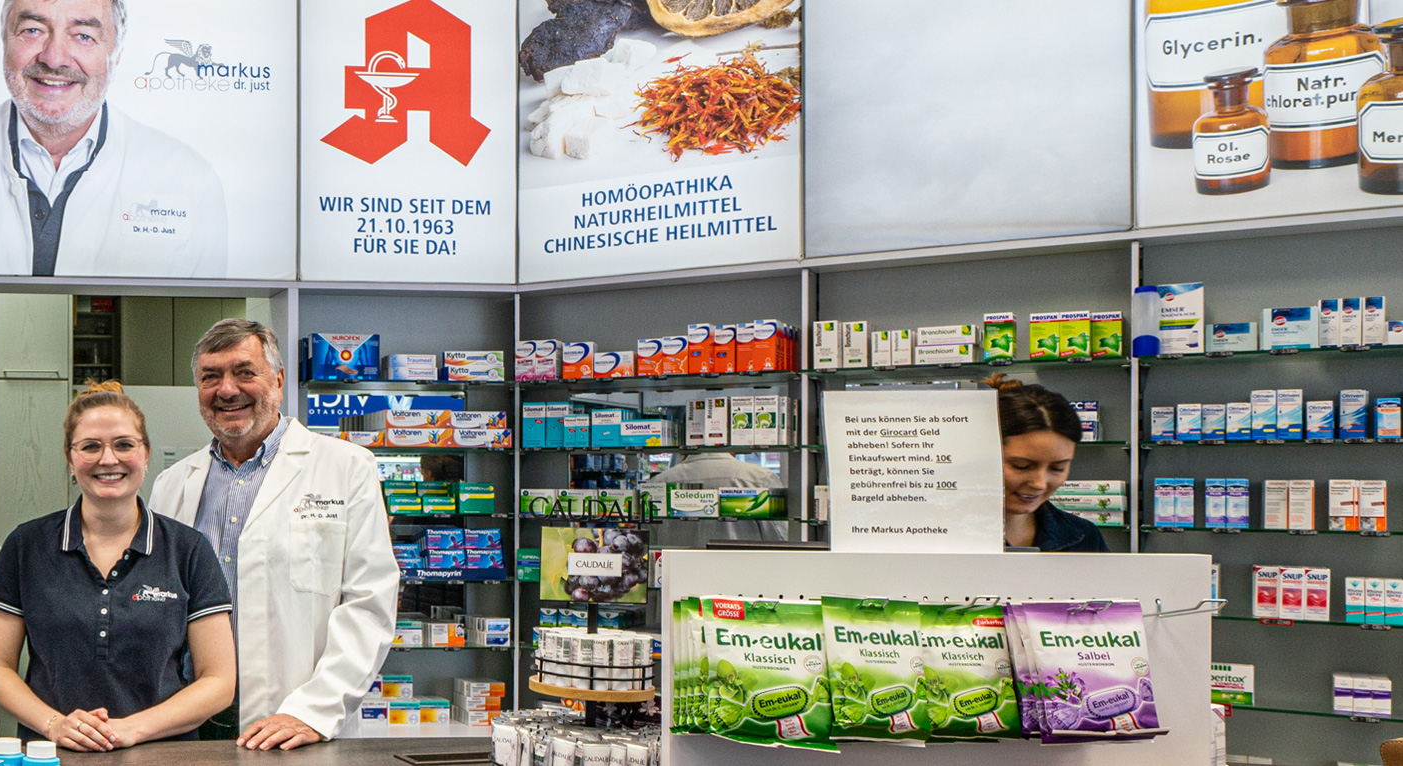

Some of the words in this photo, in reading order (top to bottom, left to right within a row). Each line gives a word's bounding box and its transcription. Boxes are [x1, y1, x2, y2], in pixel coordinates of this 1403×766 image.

[1162, 32, 1263, 58] Glycerin.
[197, 62, 271, 78] markus
[134, 74, 230, 92] apotheke
[233, 78, 247, 90] dr.
[250, 80, 270, 93] just
[1297, 75, 1347, 92] Natr.
[1207, 152, 1251, 164] Rosae
[581, 174, 733, 208] HOMÖOPATHIKA
[319, 196, 354, 214] WIR
[360, 196, 403, 214] SIND
[409, 198, 445, 215] SEIT
[451, 199, 491, 216] DEM
[151, 208, 187, 218] markus
[573, 194, 743, 230] NATURHEILMITTEL
[357, 216, 454, 236] 21.10.1963
[543, 227, 659, 254] CHINESISCHE
[665, 215, 777, 241] HEILMITTEL
[353, 235, 388, 254] FÜR
[393, 238, 419, 254] SIE
[425, 238, 457, 256] DA!
[447, 352, 465, 360] Kytta
[450, 367, 469, 375] Kytta
[391, 410, 421, 418] Voltaren
[454, 412, 482, 420] Voltaren
[880, 428, 918, 437] Girocard
[920, 428, 940, 436] Geld
[936, 455, 952, 463] 10€
[850, 468, 885, 477] beträgt,
[851, 481, 907, 490] gebührenfrei
[936, 481, 957, 490] 100€
[674, 490, 715, 500] Soledum
[851, 494, 884, 503] Bargeld
[886, 494, 927, 502] abheben.
[851, 526, 869, 534] Ihre
[871, 526, 903, 534] Markus
[906, 526, 948, 535] Apotheke
[715, 602, 742, 610] VORRATS-
[717, 609, 740, 618] GRÖSSE
[744, 652, 796, 665] Klassisch
[859, 649, 900, 659] Klassisch
[941, 652, 984, 661] Klassisch
[1077, 651, 1110, 660] Salbei
